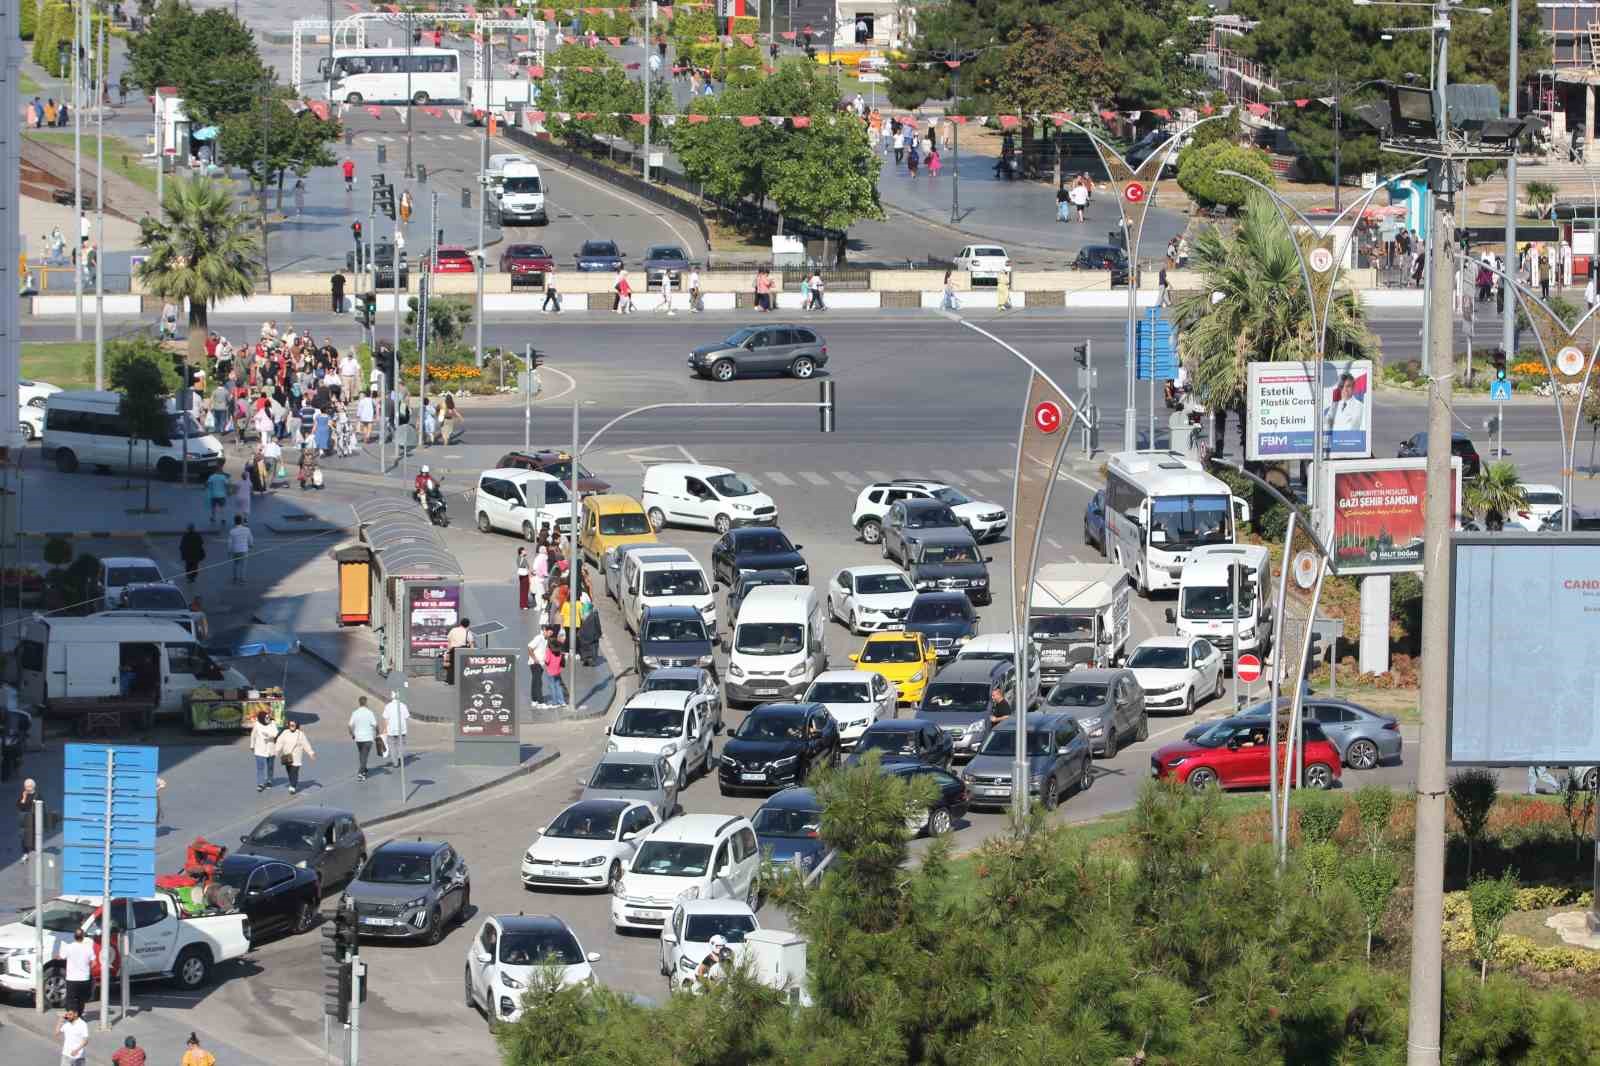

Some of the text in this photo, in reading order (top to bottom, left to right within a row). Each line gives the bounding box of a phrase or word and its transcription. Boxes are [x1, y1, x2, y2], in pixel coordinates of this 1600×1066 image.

[1260, 386, 1294, 396] Estetik
[1260, 398, 1316, 407] Plastik Cerra
[1280, 415, 1306, 425] Ekimi
[1260, 436, 1288, 447] FBM
[1384, 495, 1418, 505] SAMSUN
